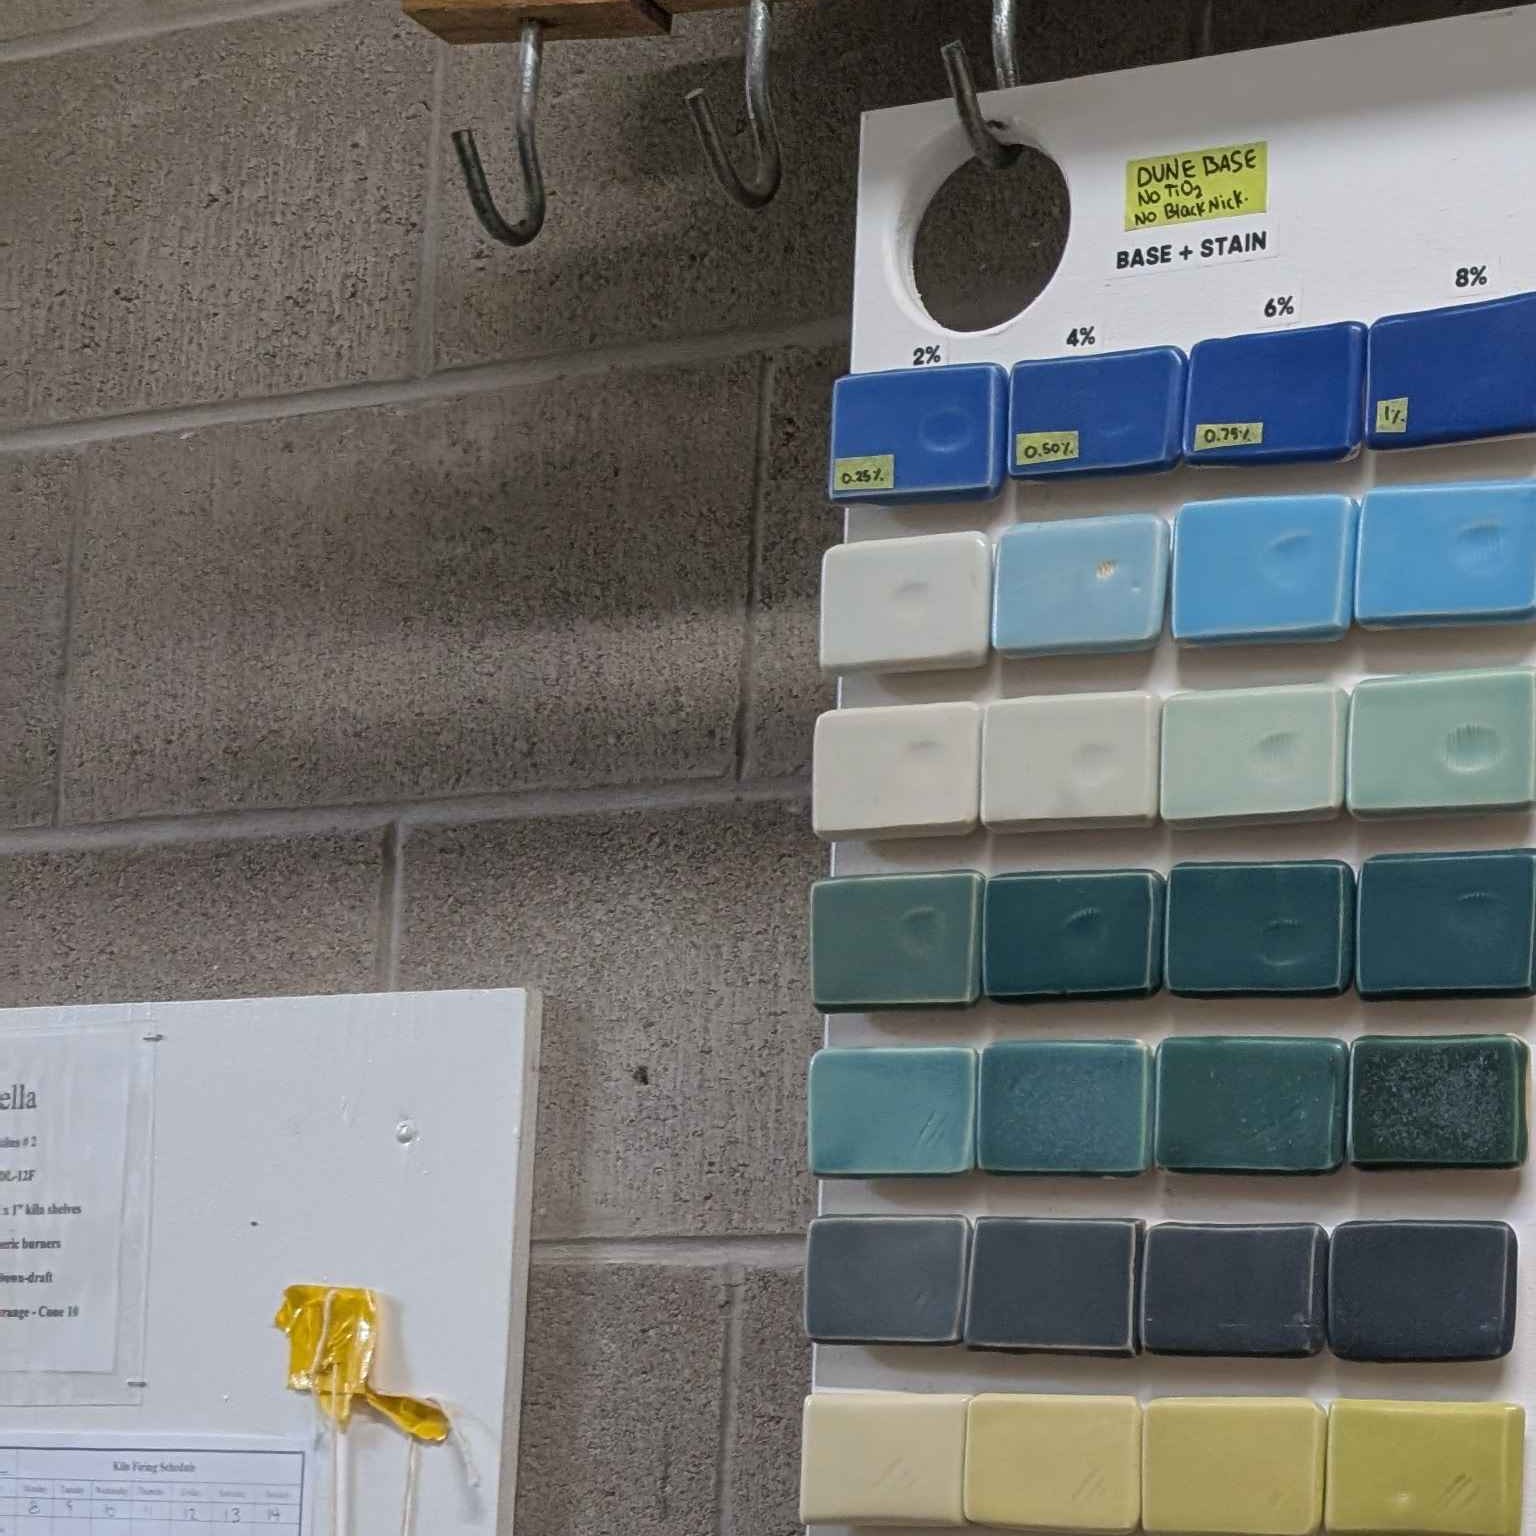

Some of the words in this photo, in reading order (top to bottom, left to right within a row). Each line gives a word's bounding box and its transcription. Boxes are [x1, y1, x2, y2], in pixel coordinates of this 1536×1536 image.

[1136, 157, 1196, 188] DUNE
[1202, 148, 1257, 177] BASE
[1116, 244, 1173, 269] BASE
[1179, 246, 1194, 261] +
[1199, 230, 1267, 258] STAIN
[1455, 265, 1488, 288] 8%
[1263, 295, 1295, 318] 6%
[1066, 326, 1096, 347] 4%
[912, 345, 942, 366] 2%
[1384, 405, 1406, 425] 1%
[1203, 426, 1251, 444] 0.75%
[1023, 442, 1075, 459] 0.50%
[841, 468, 885, 484] 0.25%
[22, 1236, 61, 1250] burners
